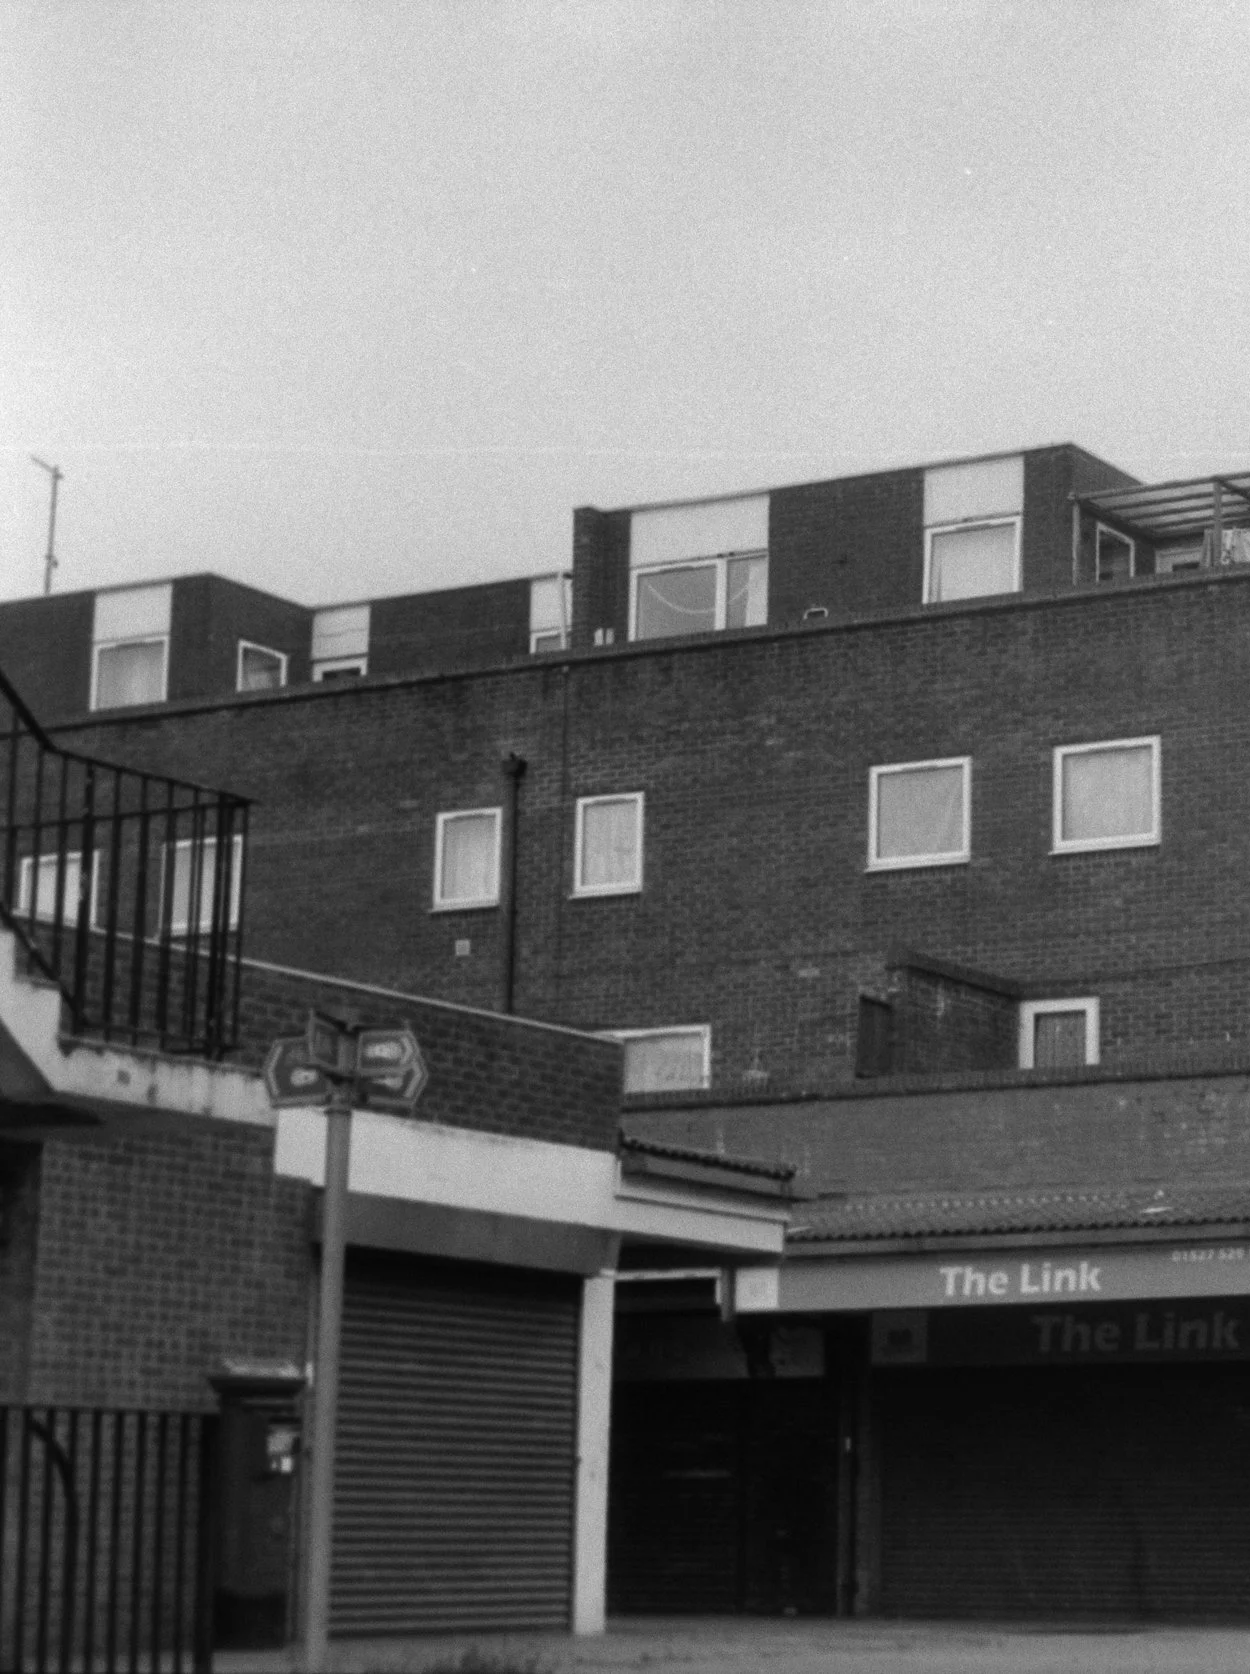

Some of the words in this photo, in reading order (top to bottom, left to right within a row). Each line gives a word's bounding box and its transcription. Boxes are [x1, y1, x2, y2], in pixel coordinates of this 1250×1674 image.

[940, 1266, 1008, 1297] The
[1020, 1262, 1102, 1294] Link
[1032, 1314, 1121, 1353] The
[1134, 1310, 1241, 1351] Link
